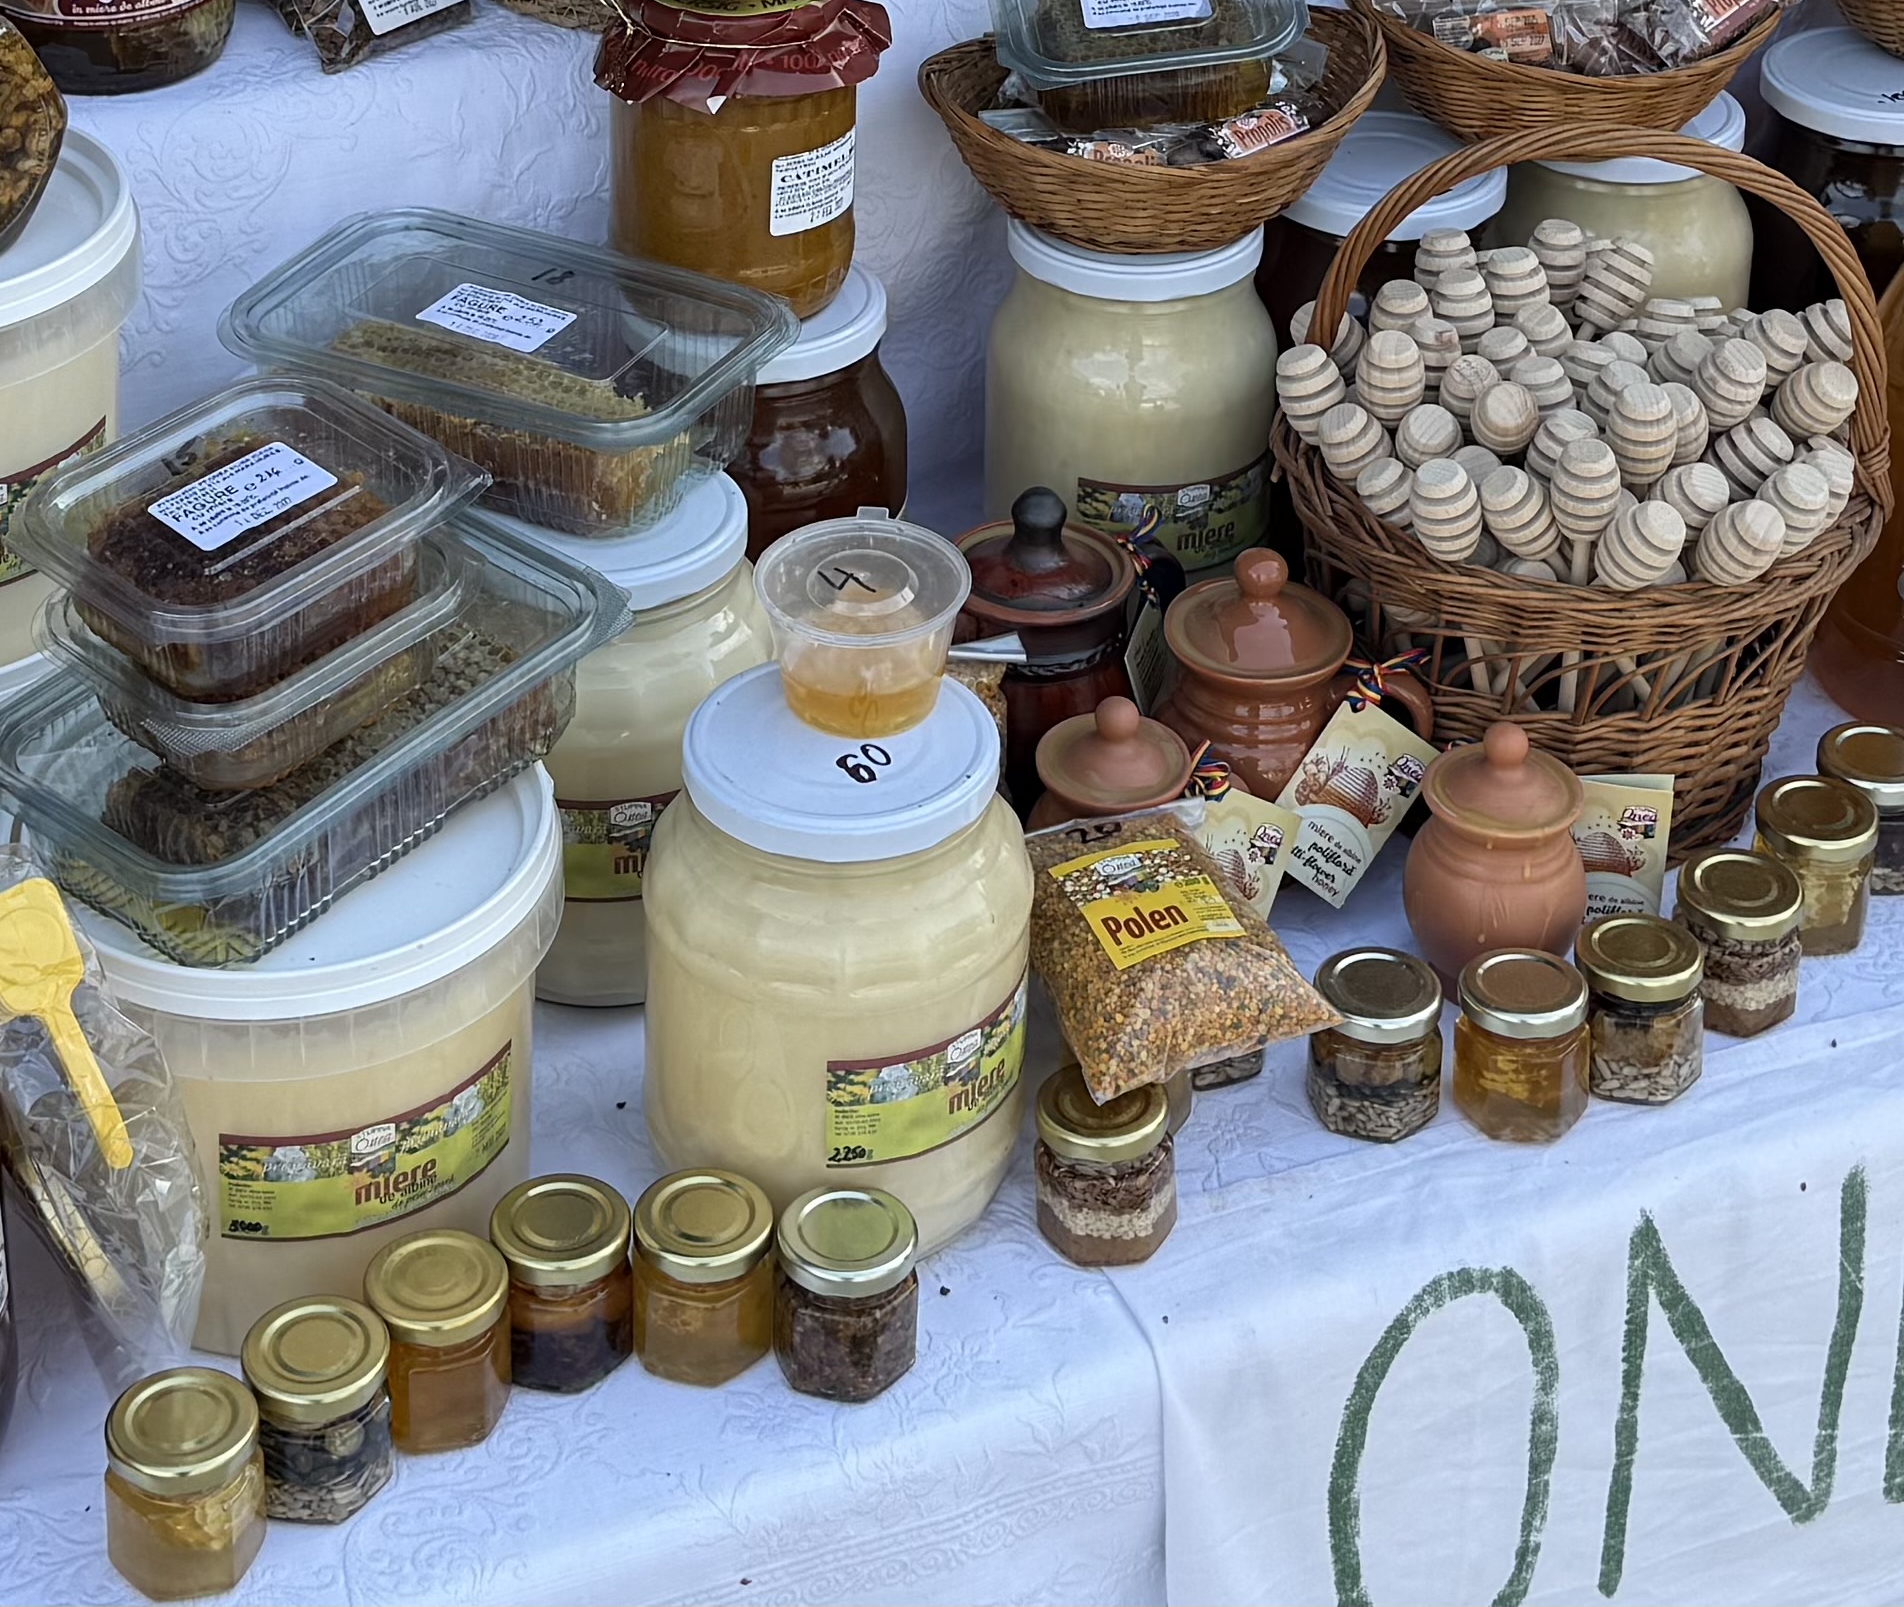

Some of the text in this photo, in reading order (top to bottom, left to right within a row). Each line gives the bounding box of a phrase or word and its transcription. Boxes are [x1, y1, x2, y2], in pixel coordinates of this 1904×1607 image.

[1234, 109, 1292, 150] Propolis
[171, 484, 240, 524] FAGURE
[837, 743, 892, 783] 60
[1101, 902, 1189, 948] Polen
[949, 1060, 1006, 1116] miere
[353, 1156, 437, 1207] miere
